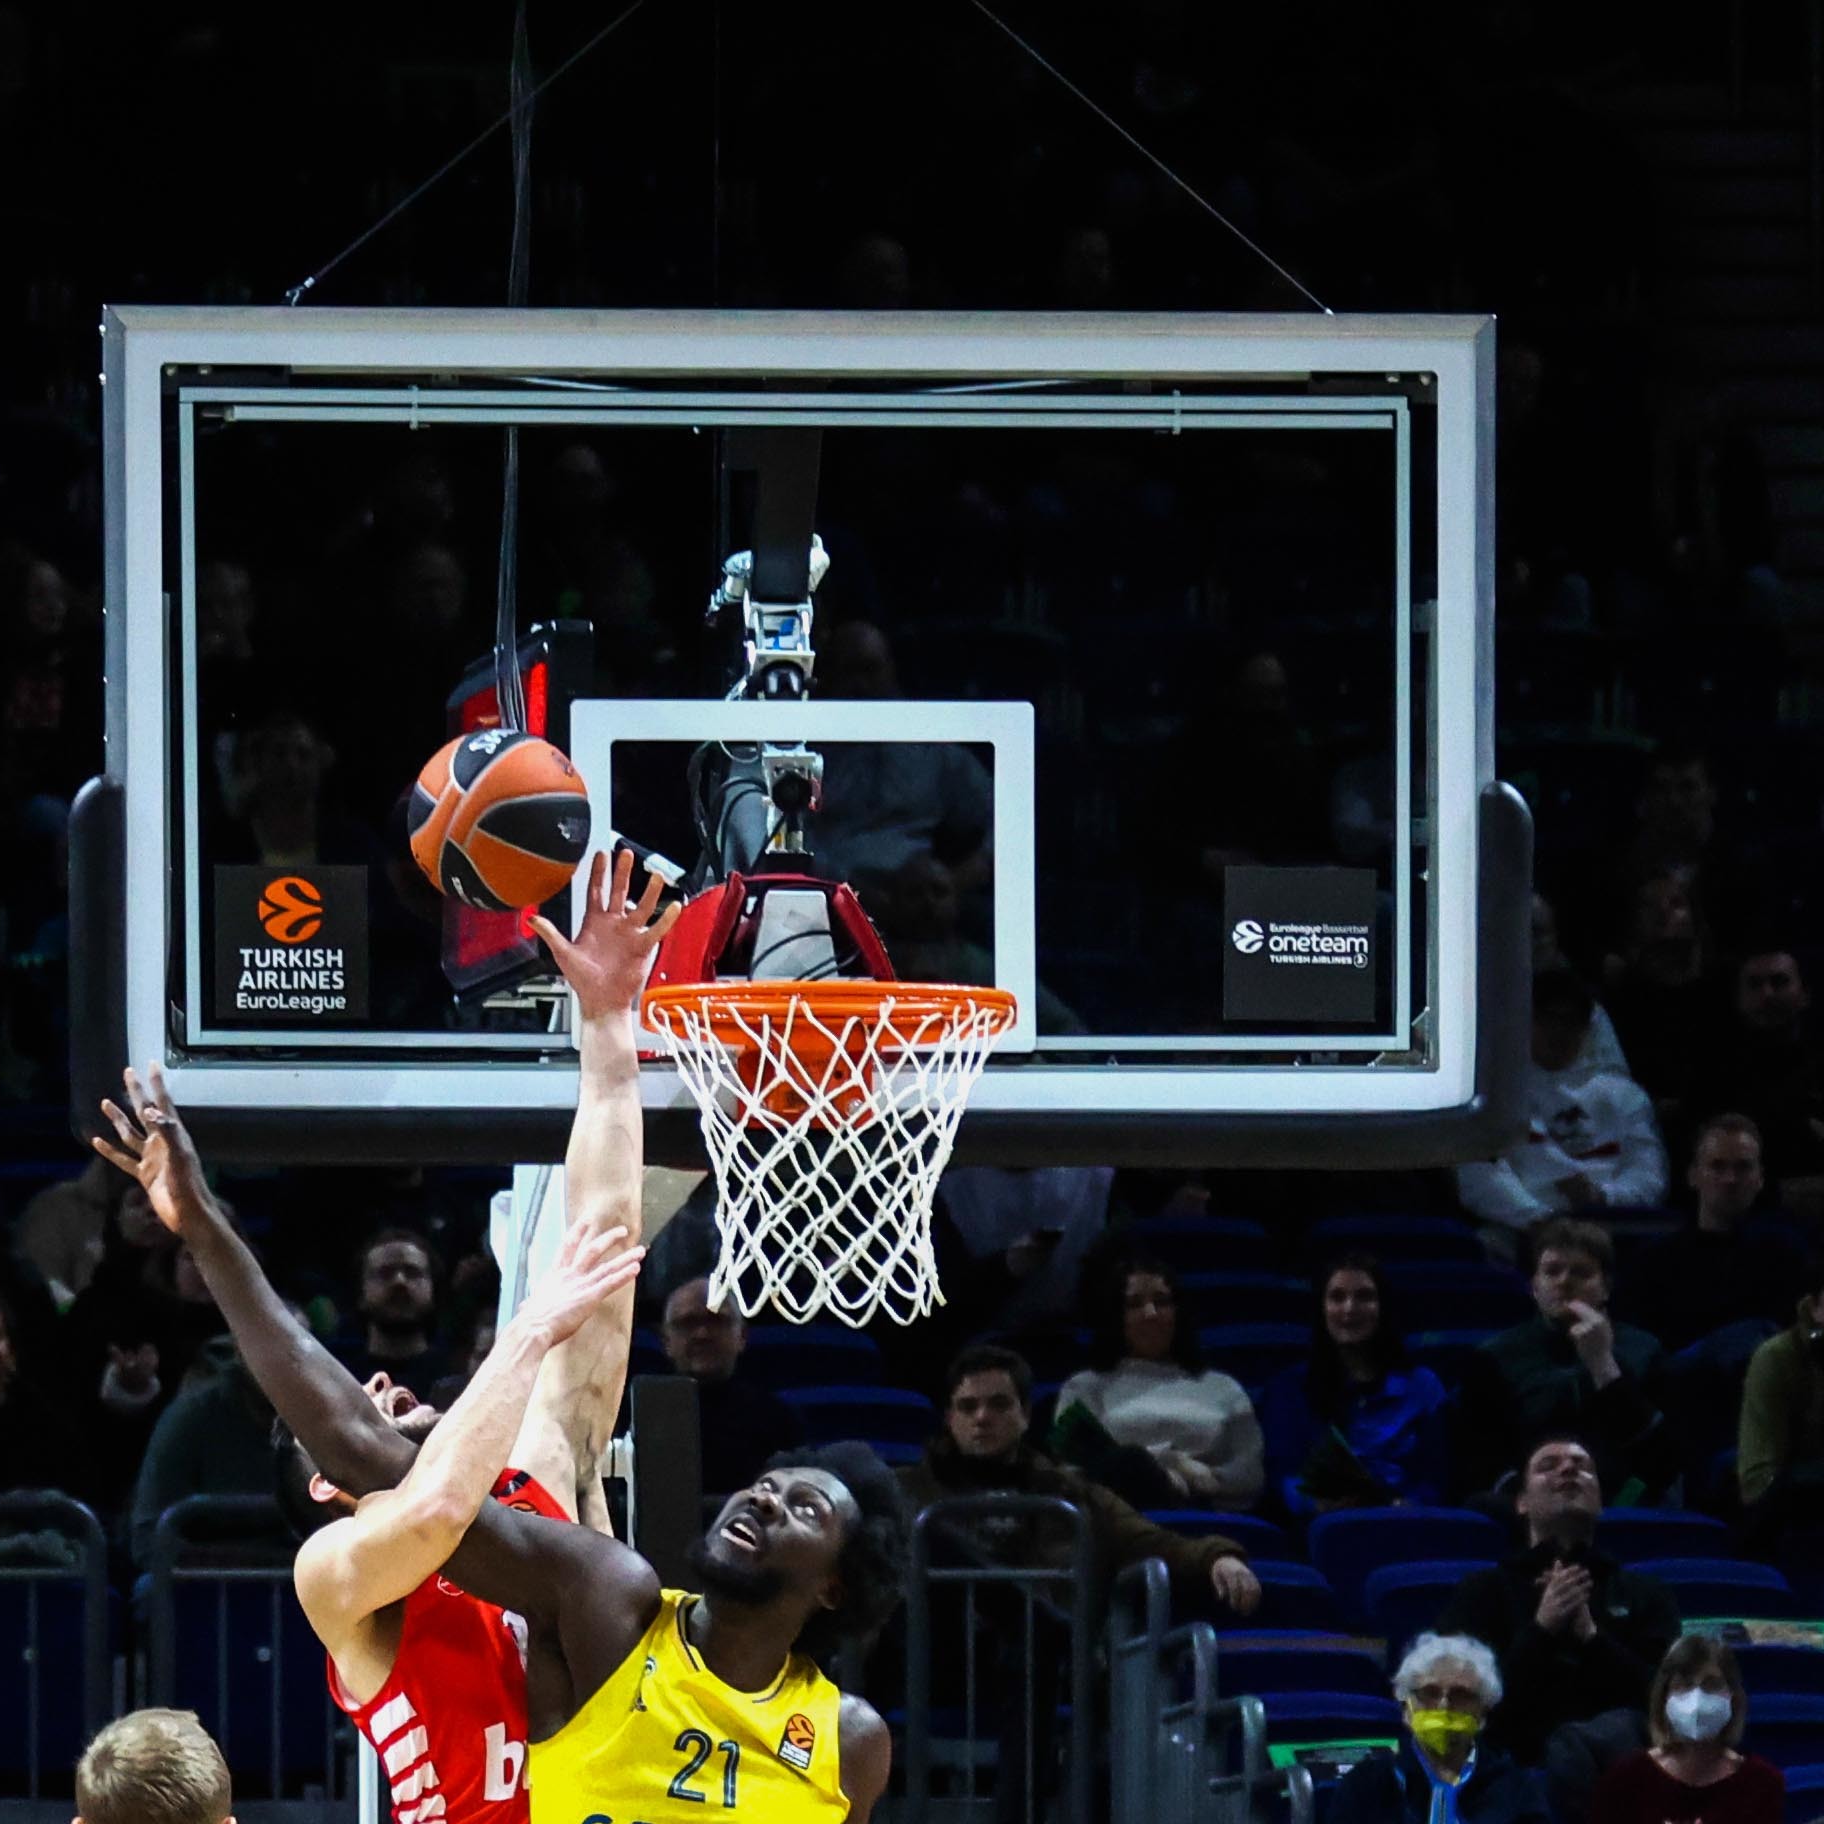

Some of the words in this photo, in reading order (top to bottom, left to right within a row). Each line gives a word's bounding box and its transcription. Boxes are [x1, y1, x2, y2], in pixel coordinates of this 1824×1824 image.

[1269, 934, 1368, 953] oneteam
[239, 948, 344, 968] TURKISH
[238, 970, 345, 990] AIRLINES
[236, 992, 347, 1014] EuroLeague
[666, 1727, 741, 1809] 21
